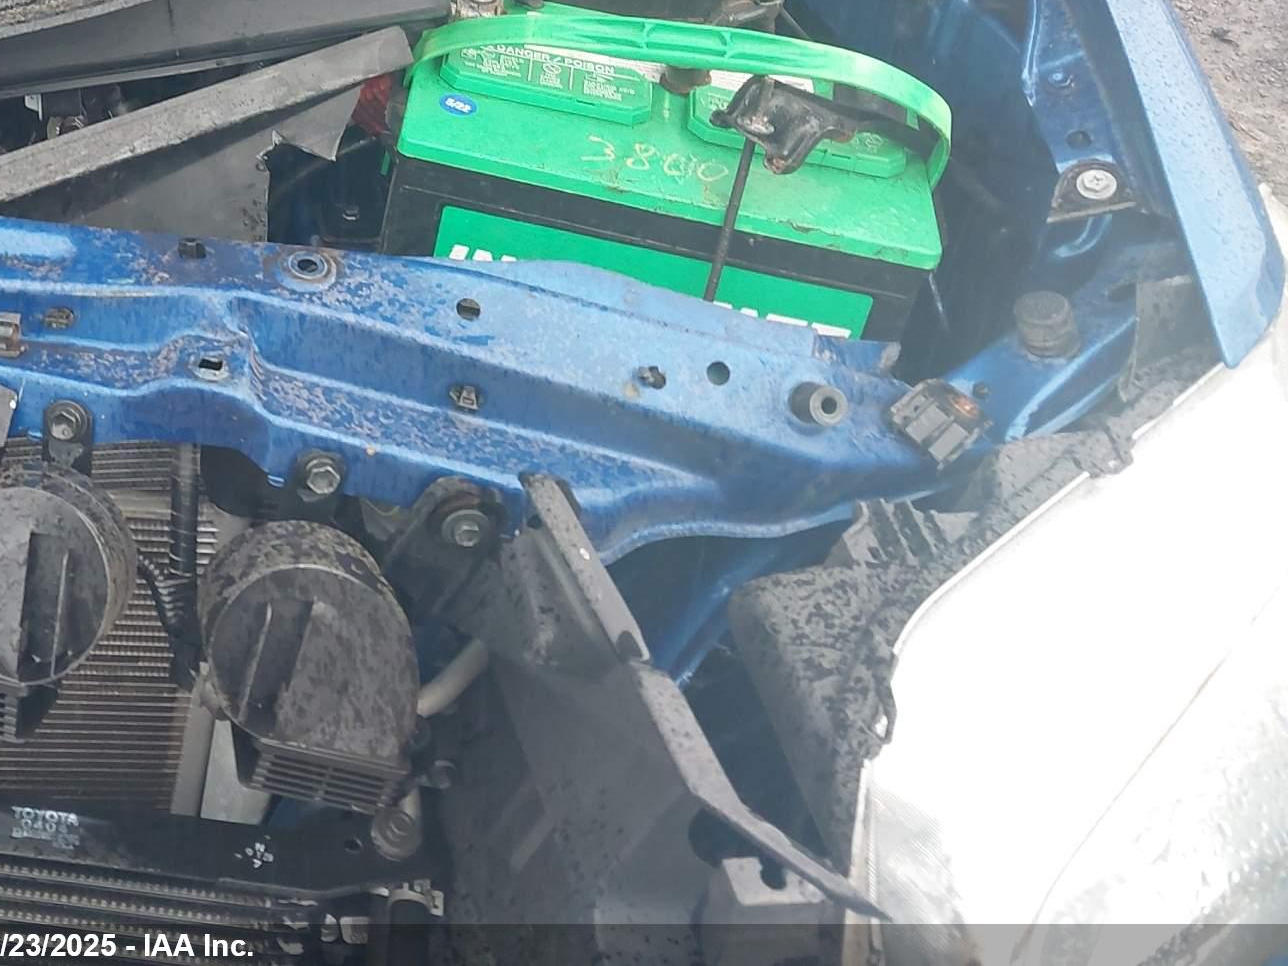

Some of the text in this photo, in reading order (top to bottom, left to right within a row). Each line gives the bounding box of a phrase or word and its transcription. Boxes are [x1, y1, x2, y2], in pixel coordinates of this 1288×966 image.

[496, 44, 550, 62] DANGER
[564, 57, 616, 75] POISON
[11, 806, 80, 827] TOYOTA
